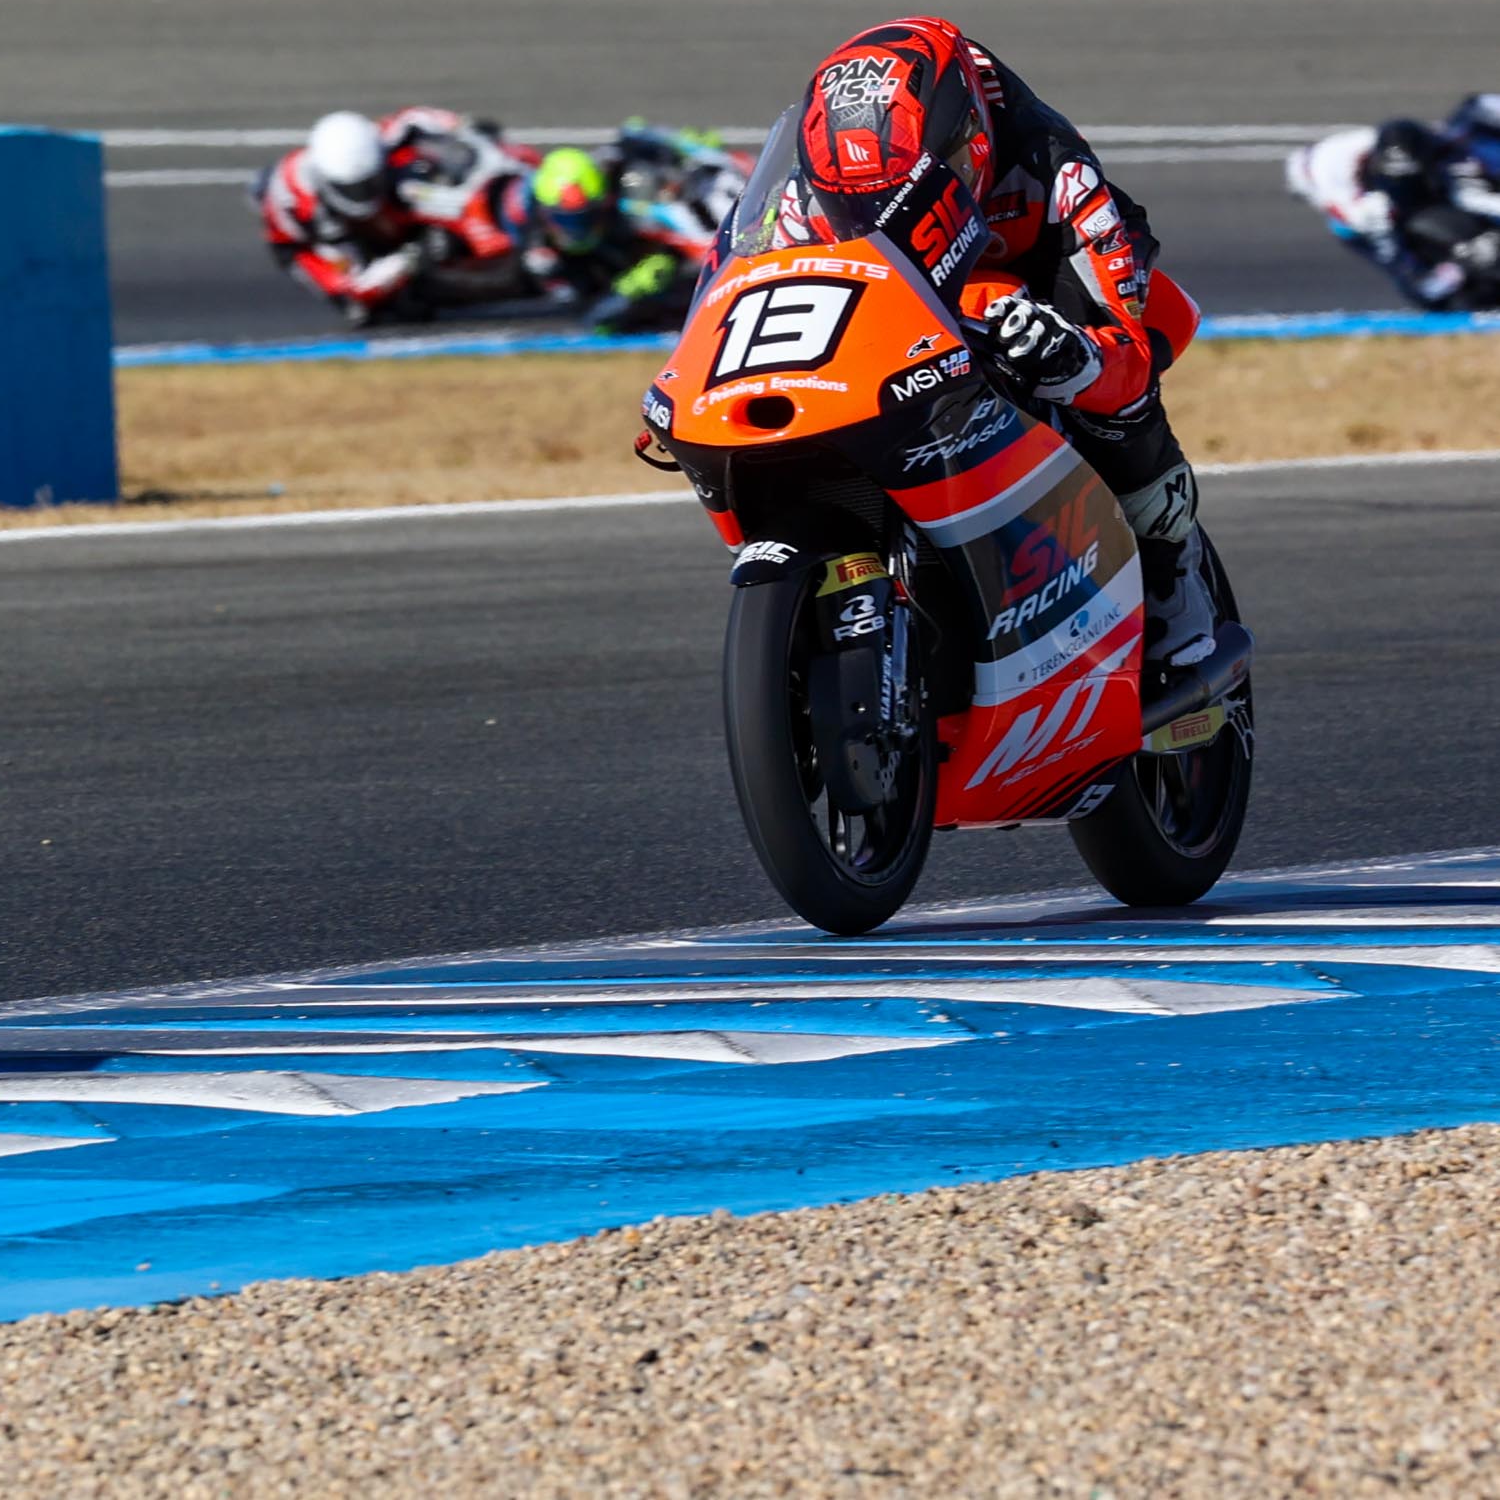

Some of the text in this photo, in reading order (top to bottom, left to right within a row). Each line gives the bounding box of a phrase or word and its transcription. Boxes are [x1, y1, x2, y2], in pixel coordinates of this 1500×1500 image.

[821, 56, 897, 91] DAN
[910, 177, 974, 269] SIC
[930, 216, 980, 287] RACING
[716, 285, 853, 378] 13
[709, 376, 848, 404] Printing Emotions
[986, 540, 1099, 640] RACING
[833, 616, 886, 641] RCB
